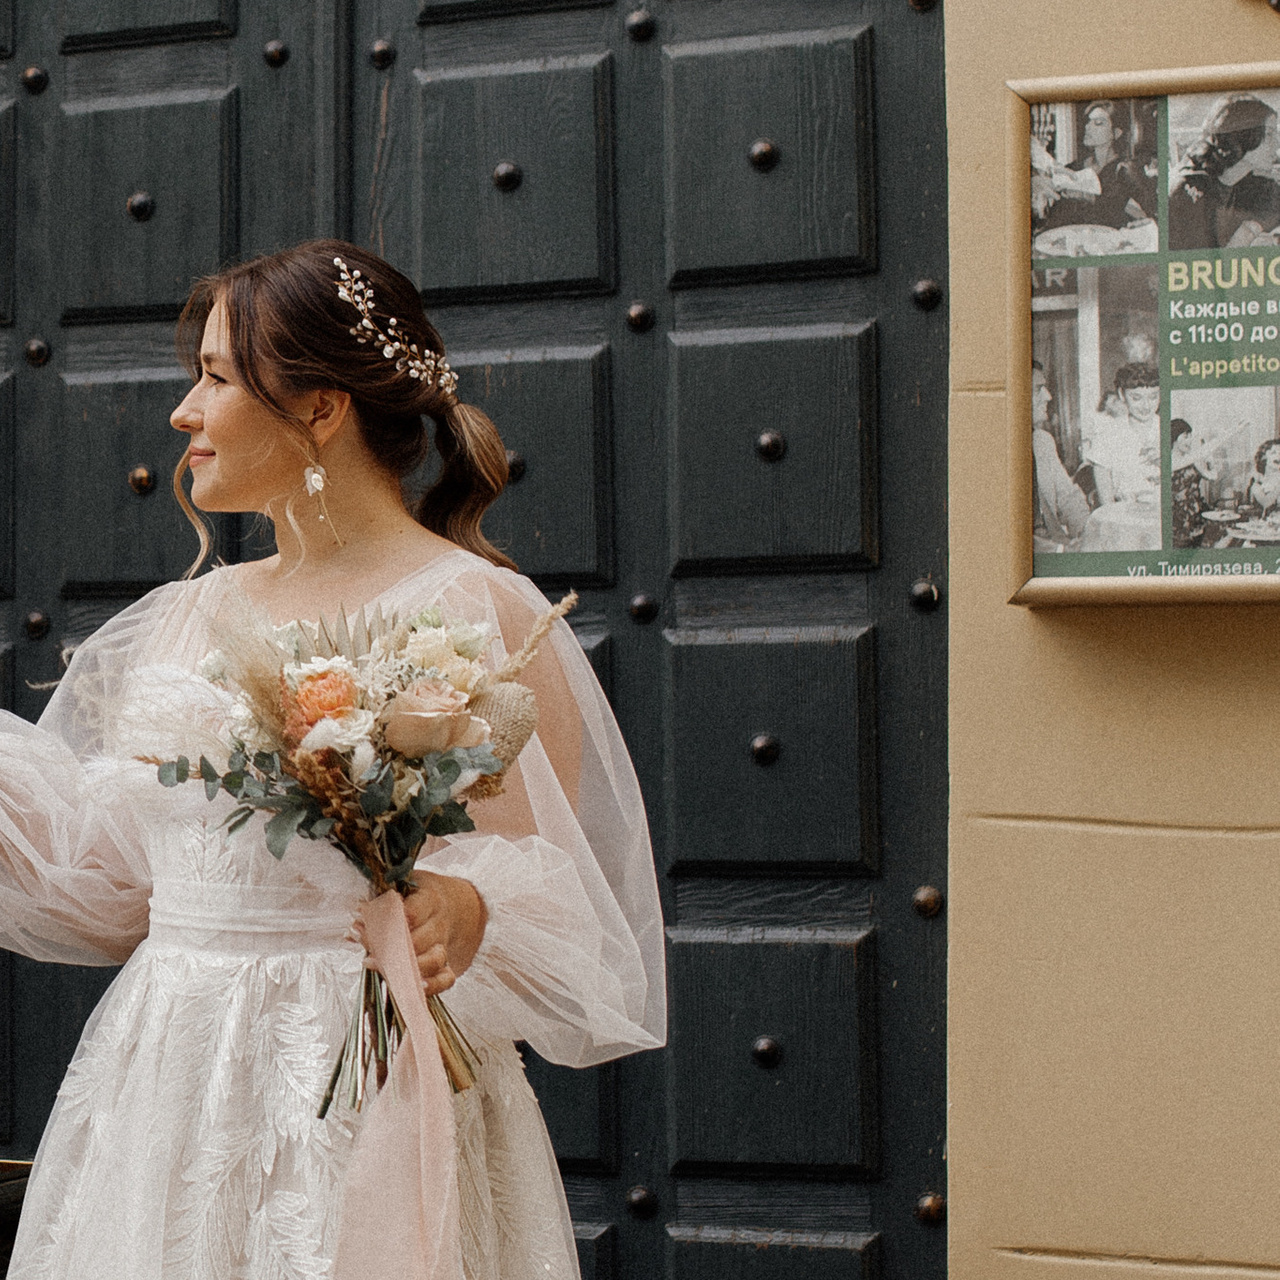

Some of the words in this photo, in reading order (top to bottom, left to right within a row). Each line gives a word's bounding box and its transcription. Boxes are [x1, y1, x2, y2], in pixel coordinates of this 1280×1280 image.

[1170, 299, 1260, 320] Каждые
[1266, 299, 1280, 315] в
[1169, 329, 1182, 345] с
[1188, 322, 1244, 344] 11:00
[1250, 325, 1278, 343] до
[1170, 353, 1280, 380] L'appetito
